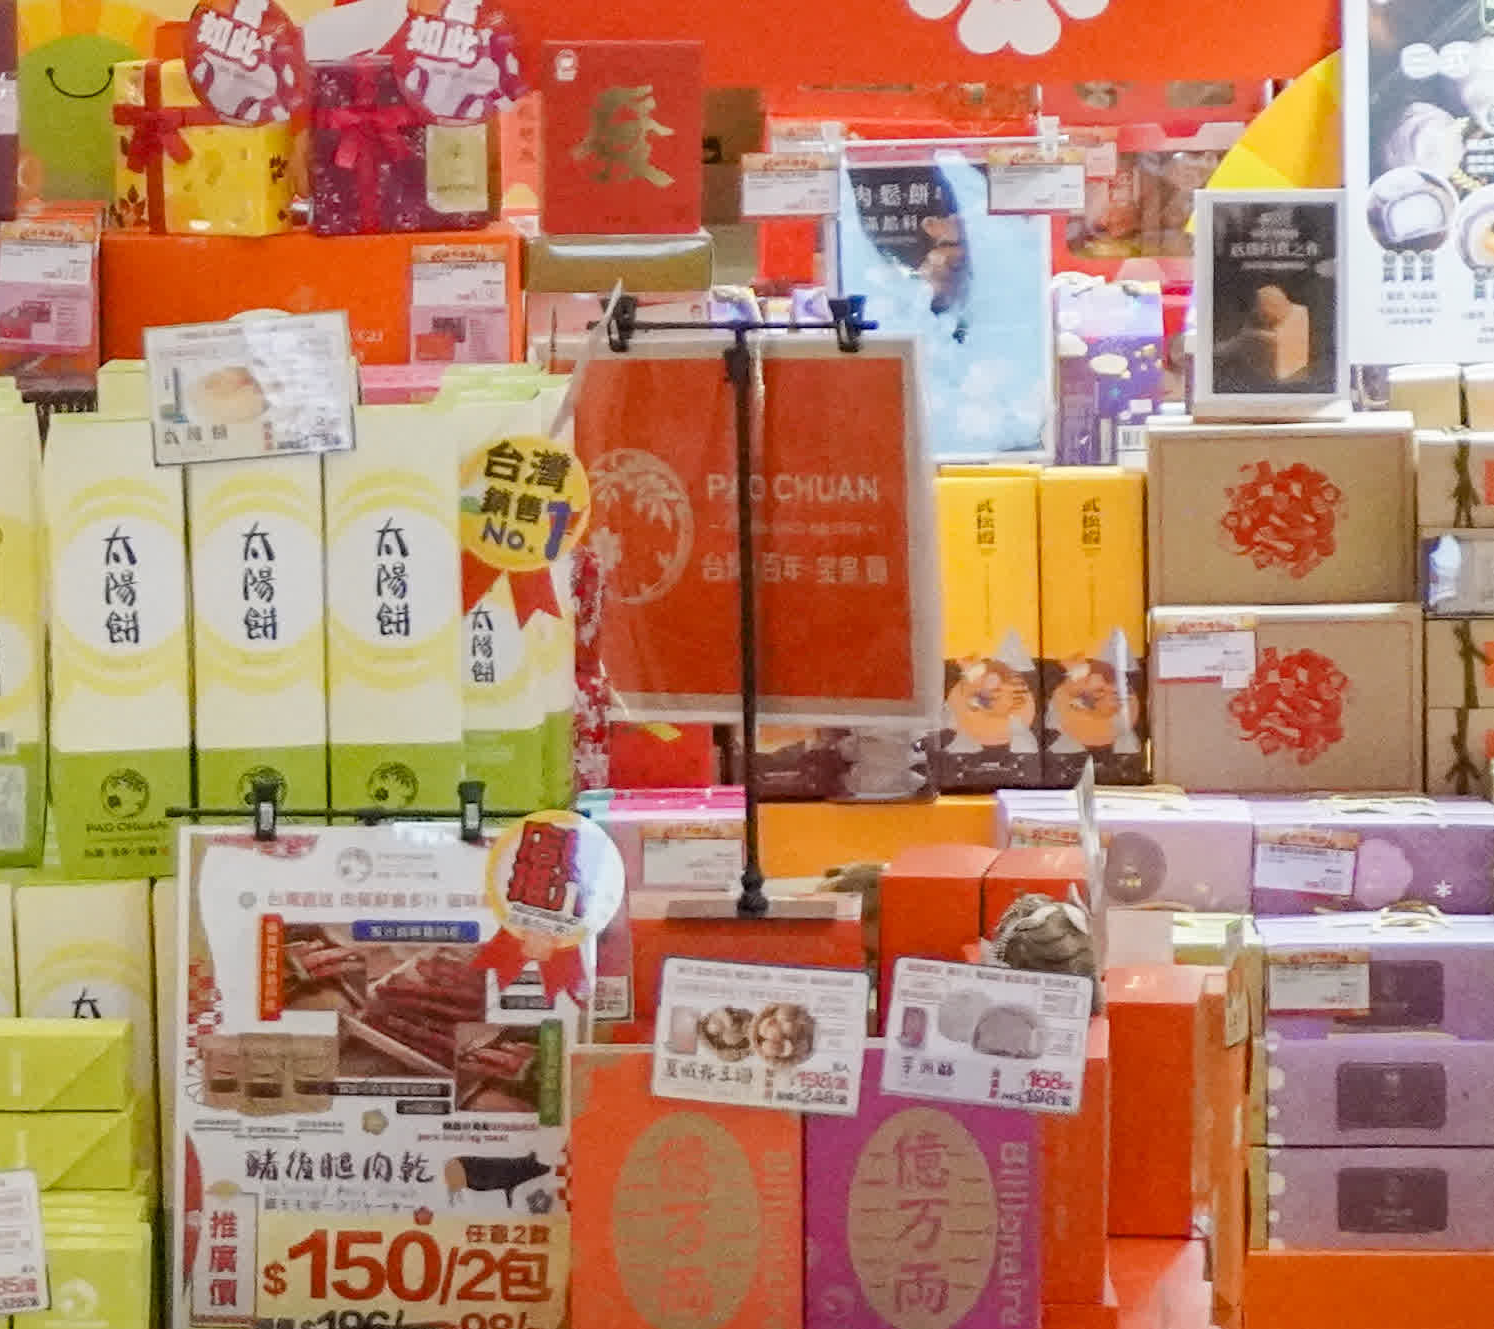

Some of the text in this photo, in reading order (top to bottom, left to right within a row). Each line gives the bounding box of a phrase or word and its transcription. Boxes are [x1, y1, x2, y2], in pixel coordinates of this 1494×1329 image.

[479, 487, 543, 526] 銷售
[483, 441, 573, 495] 台灣
[772, 473, 879, 504] CHUAN
[104, 524, 140, 645] 太陽餅
[242, 521, 278, 643] 太陽餅
[375, 517, 411, 639] 太陽餅
[1000, 1138, 1030, 1328] Billionaire
